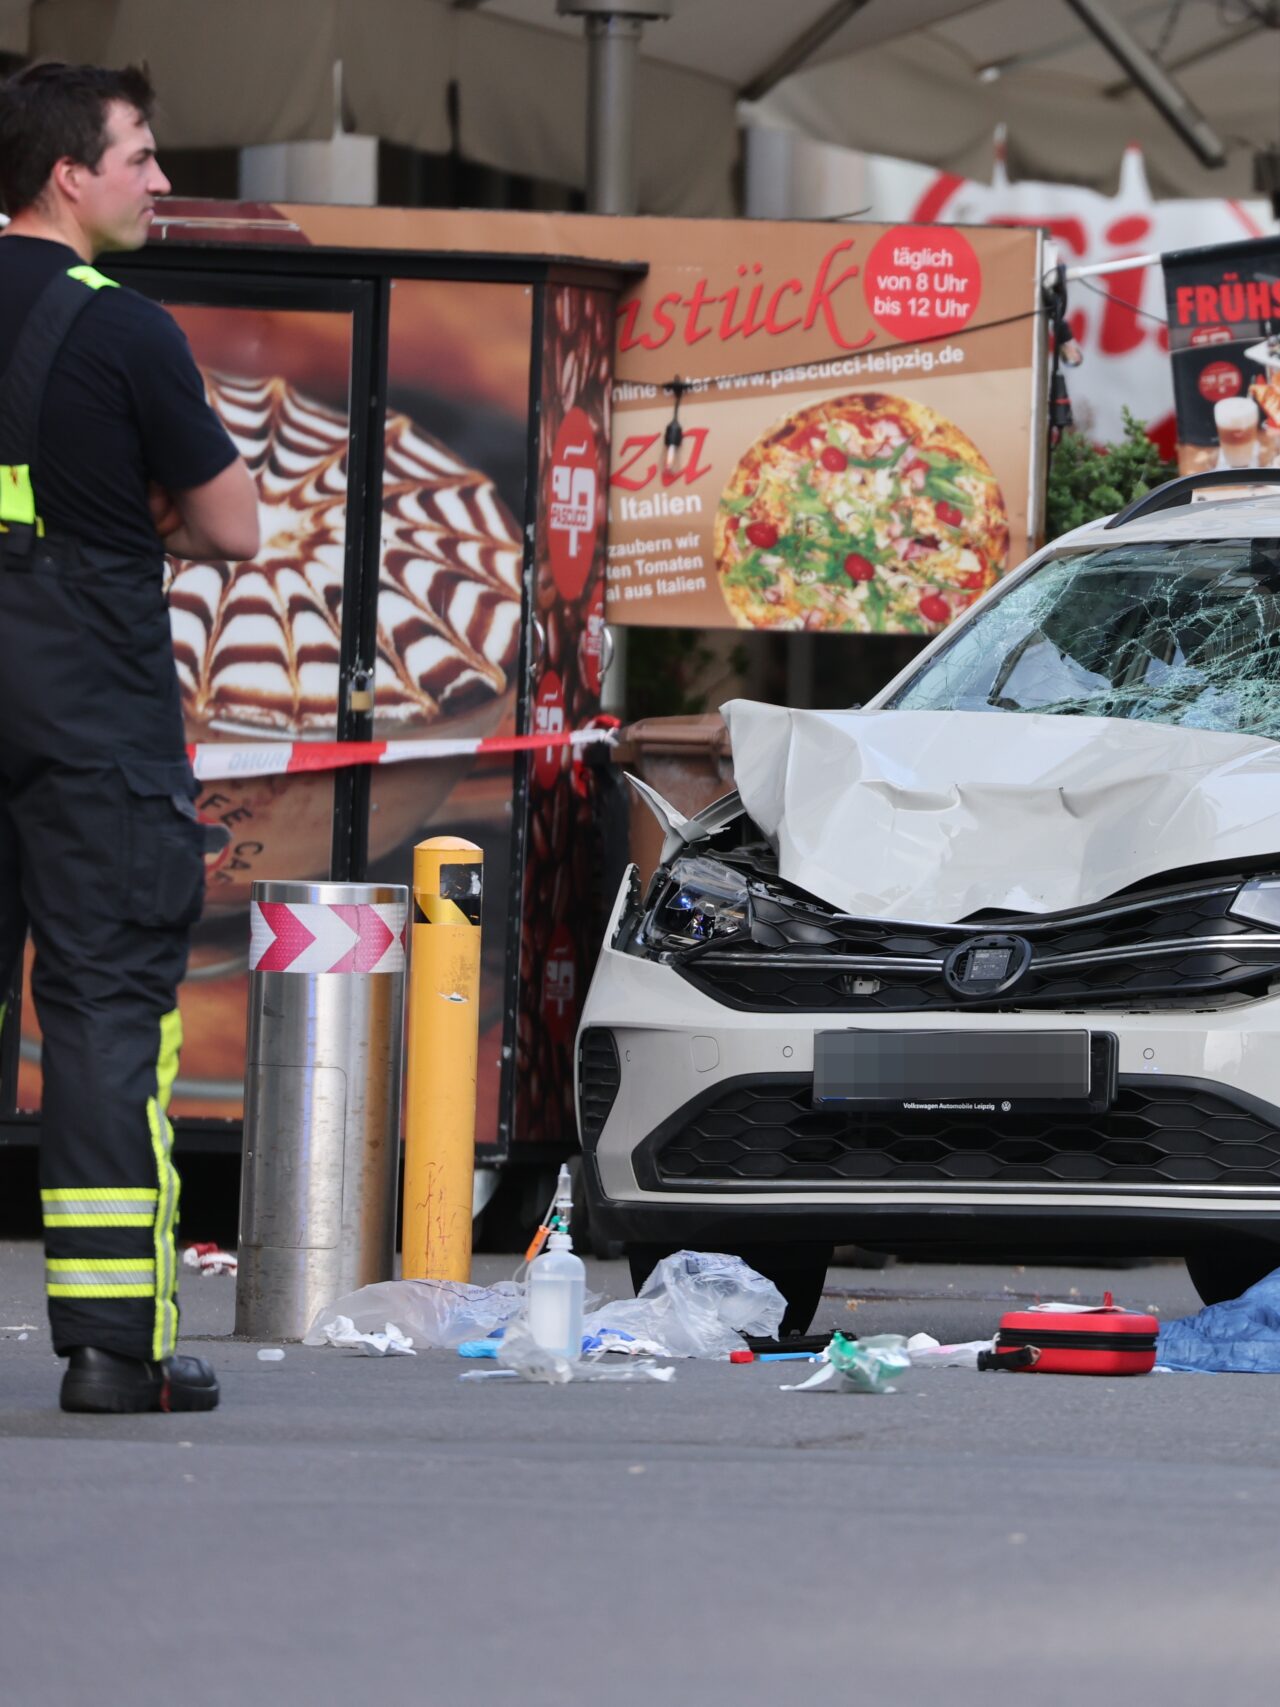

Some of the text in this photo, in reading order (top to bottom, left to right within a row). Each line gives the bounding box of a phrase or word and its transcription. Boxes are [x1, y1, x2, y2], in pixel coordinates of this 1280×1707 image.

[893, 247, 953, 270] täglich
[877, 272, 968, 292] von 8 Uhr
[874, 296, 970, 318] bis 12 Uhr
[715, 345, 964, 390] www.pascucci-leipzig.de
[620, 492, 702, 521] Italien
[608, 531, 700, 557] zaubern wir
[635, 554, 704, 577] Tomaten
[624, 584, 653, 600] aus
[656, 575, 706, 596] Italien
[903, 1102, 938, 1110] Volkswagen
[974, 1102, 995, 1111] Leipzig
